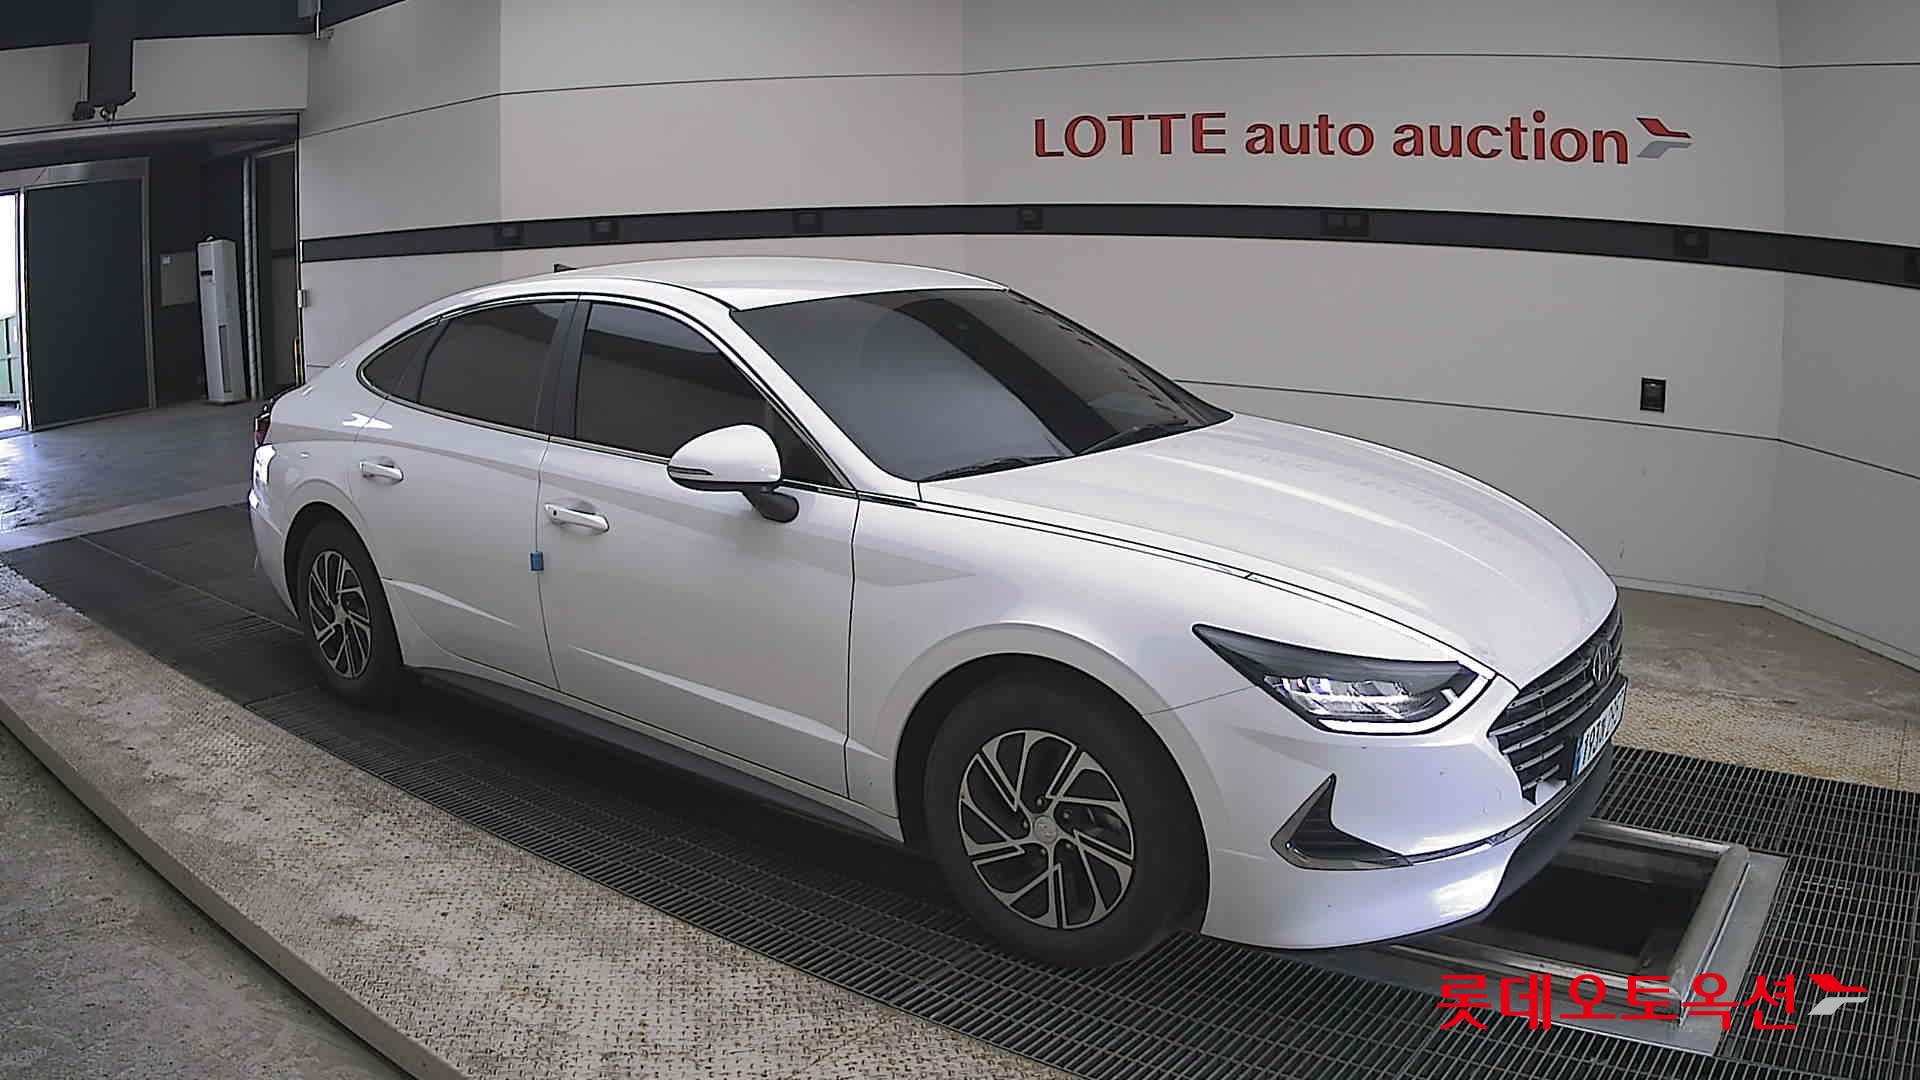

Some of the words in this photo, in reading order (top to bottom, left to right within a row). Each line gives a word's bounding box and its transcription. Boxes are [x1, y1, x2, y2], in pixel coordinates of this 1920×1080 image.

[1034, 112, 1227, 158] LOTTE
[1244, 114, 1375, 156] auto
[1391, 110, 1629, 165] auction
